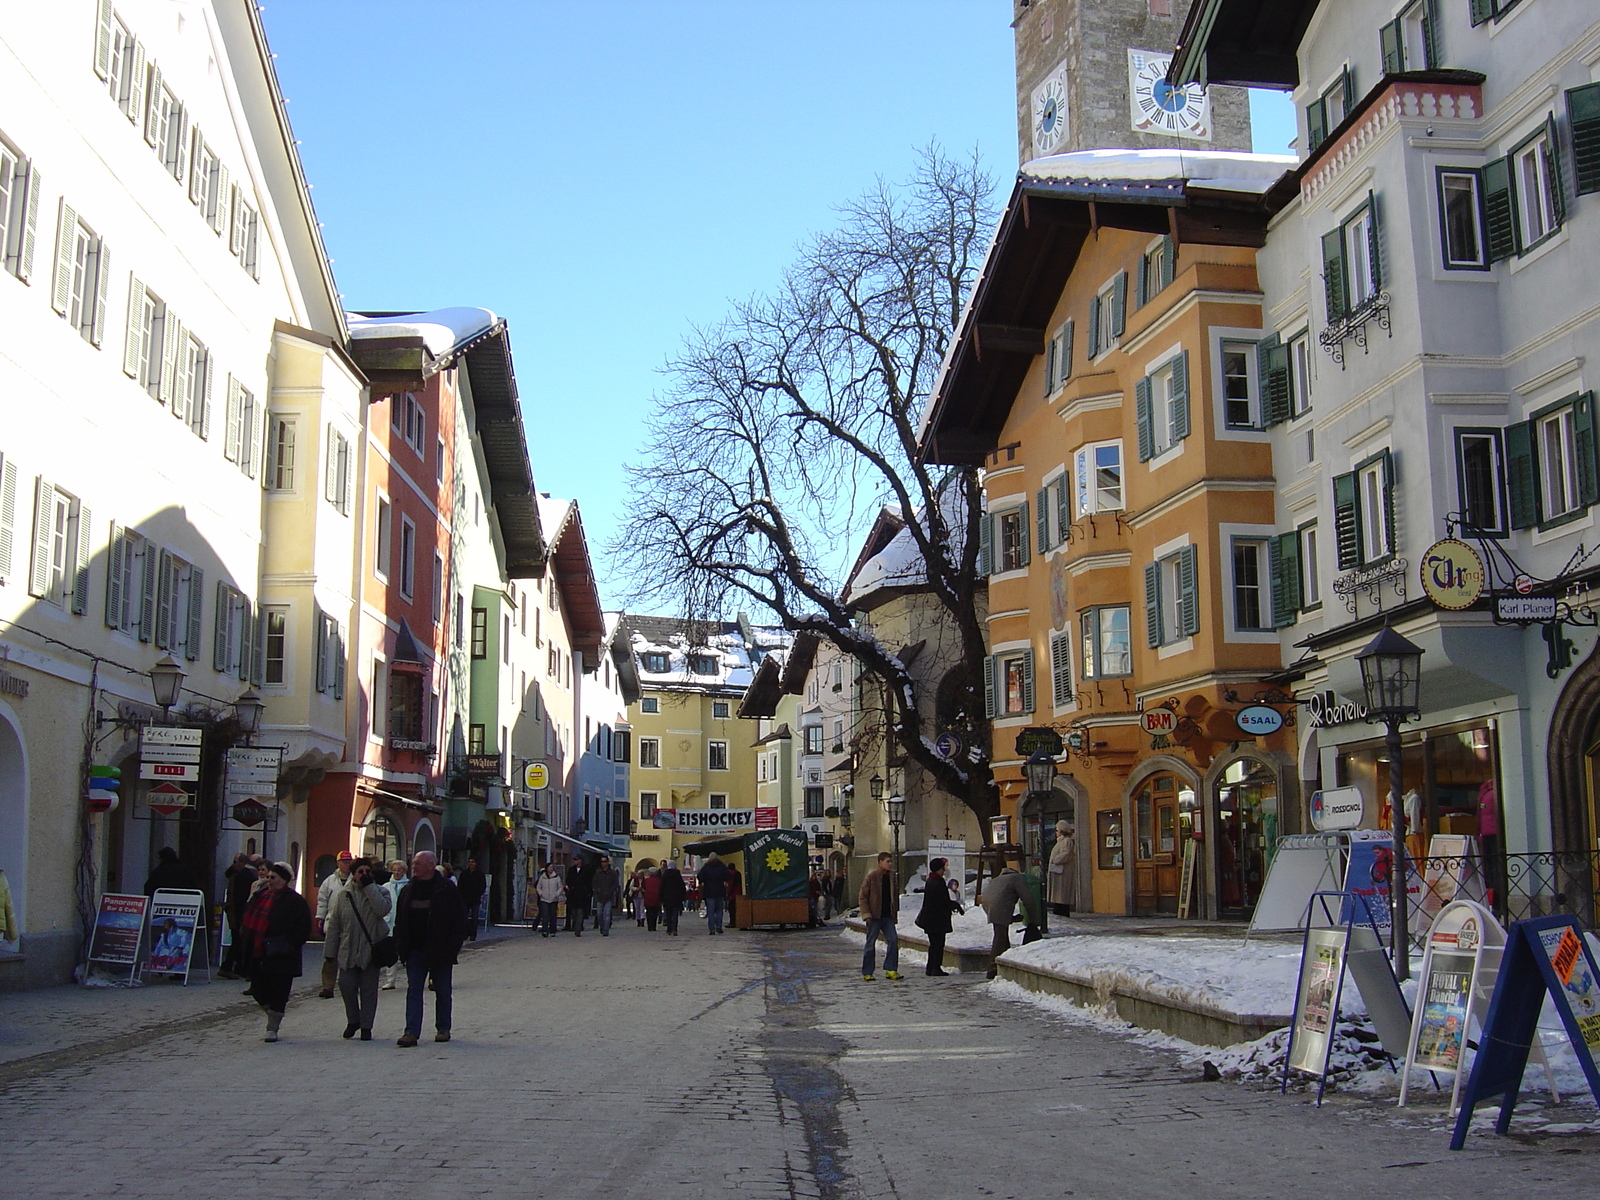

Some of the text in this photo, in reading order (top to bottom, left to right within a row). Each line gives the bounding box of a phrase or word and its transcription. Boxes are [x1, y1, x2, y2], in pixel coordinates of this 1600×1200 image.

[1500, 604, 1553, 613] Karl Planer
[1325, 690, 1369, 724] benetto
[1251, 715, 1277, 725] SAAL
[1332, 804, 1361, 814] ROSSIGNOL
[678, 811, 752, 826] EISHOCKEY
[104, 897, 143, 907] Panorama
[154, 907, 178, 915] JETZT
[1555, 931, 1579, 980] FINALE
[1432, 973, 1458, 990] ROYAL
[1429, 988, 1460, 1006] Dancing
